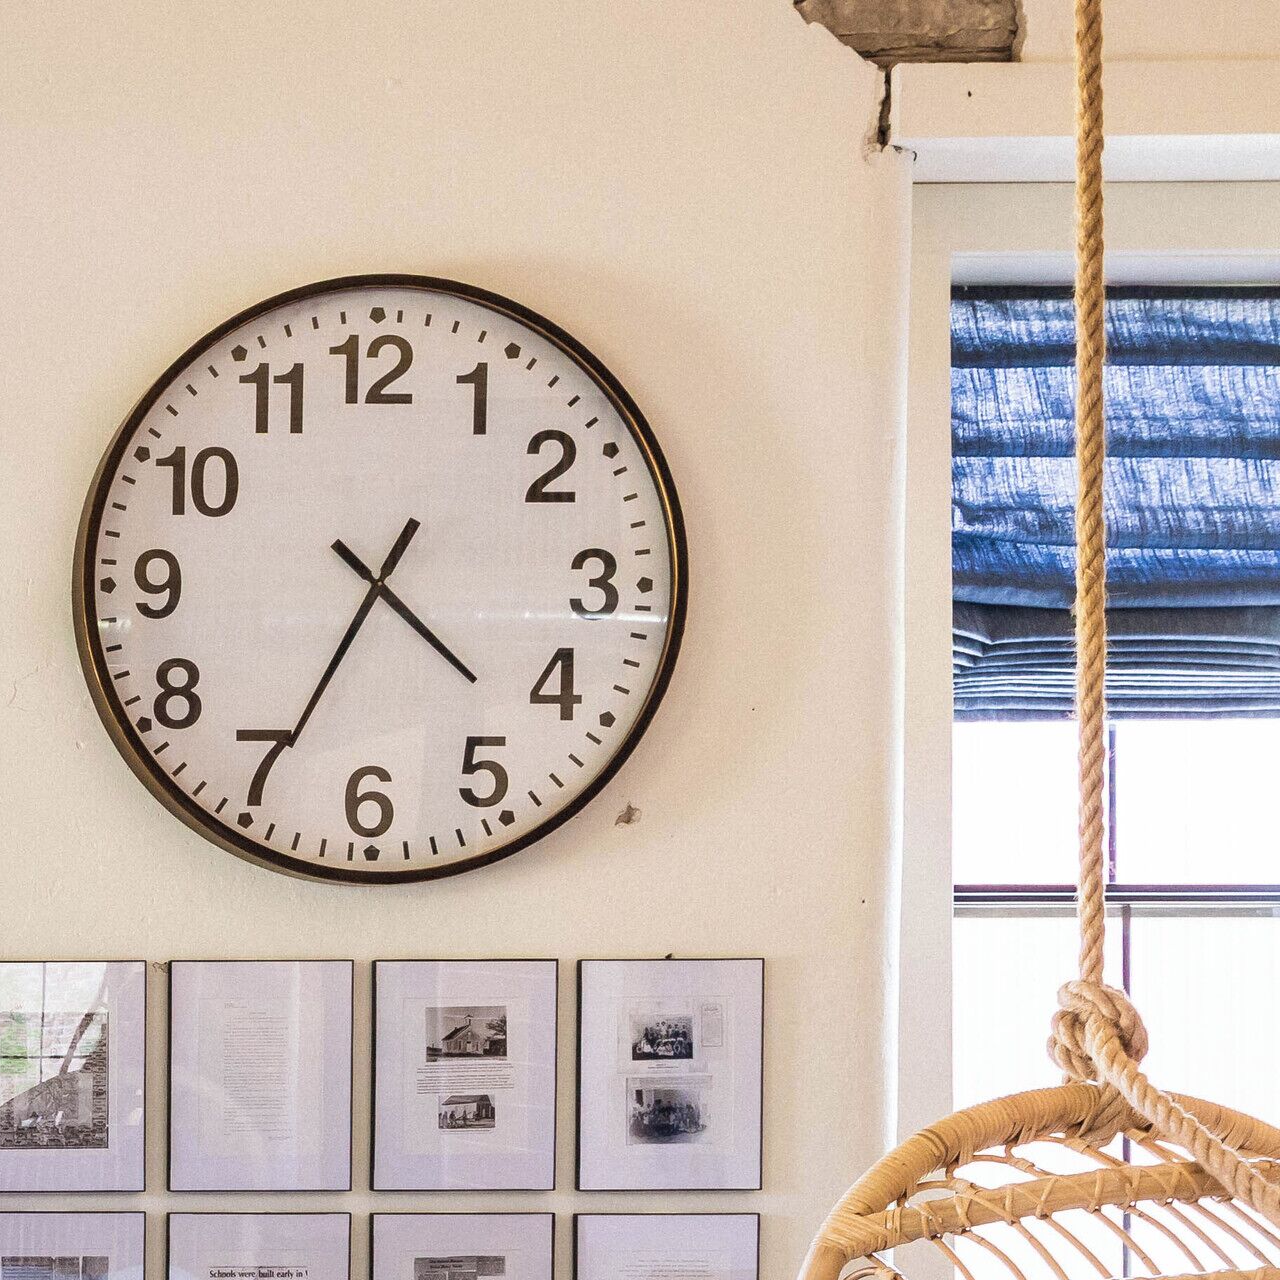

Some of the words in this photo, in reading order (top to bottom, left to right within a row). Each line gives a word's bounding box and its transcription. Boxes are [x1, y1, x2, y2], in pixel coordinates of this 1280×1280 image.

[240, 362, 304, 433] 11
[330, 334, 413, 404] 12
[456, 362, 487, 435] 1
[156, 446, 239, 517] 10
[525, 430, 577, 503] 2
[134, 549, 182, 619] 9
[570, 548, 619, 620] 3
[153, 658, 202, 729] 8
[530, 648, 582, 721] 4
[236, 729, 293, 807] 7
[345, 766, 394, 838] 6
[459, 736, 509, 808] 5
[209, 1270, 236, 1278] Schools
[258, 1269, 275, 1278] built
[276, 1269, 293, 1280] early
[296, 1269, 303, 1278] in
